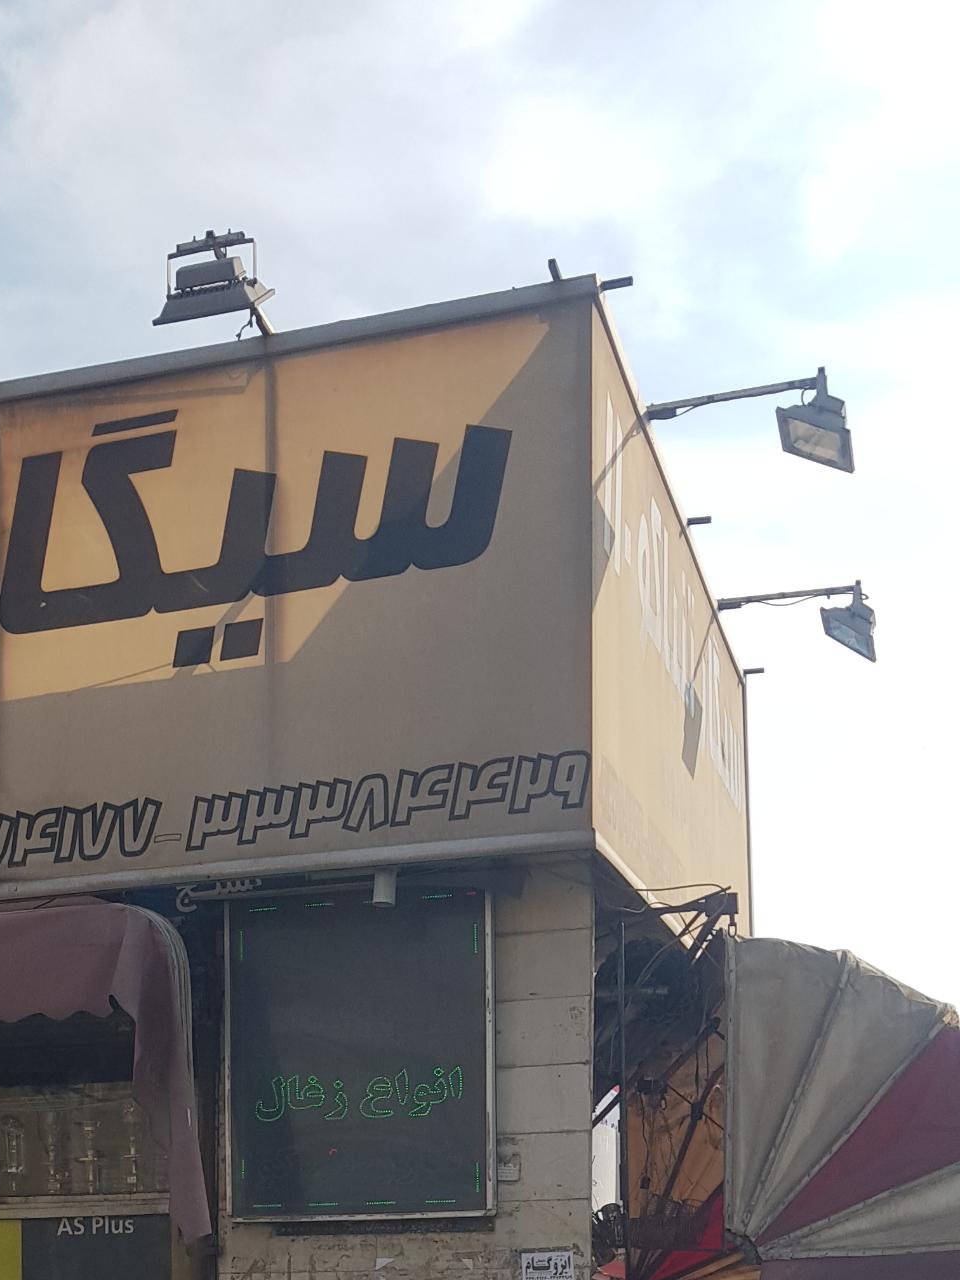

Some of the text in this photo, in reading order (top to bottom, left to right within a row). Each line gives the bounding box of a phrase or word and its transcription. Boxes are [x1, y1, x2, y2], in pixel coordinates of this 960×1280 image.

[255, 1066, 464, 1122] انواع زغال
[57, 1215, 135, 1236] AS Plus
[525, 1253, 571, 1275] ایزوگام
